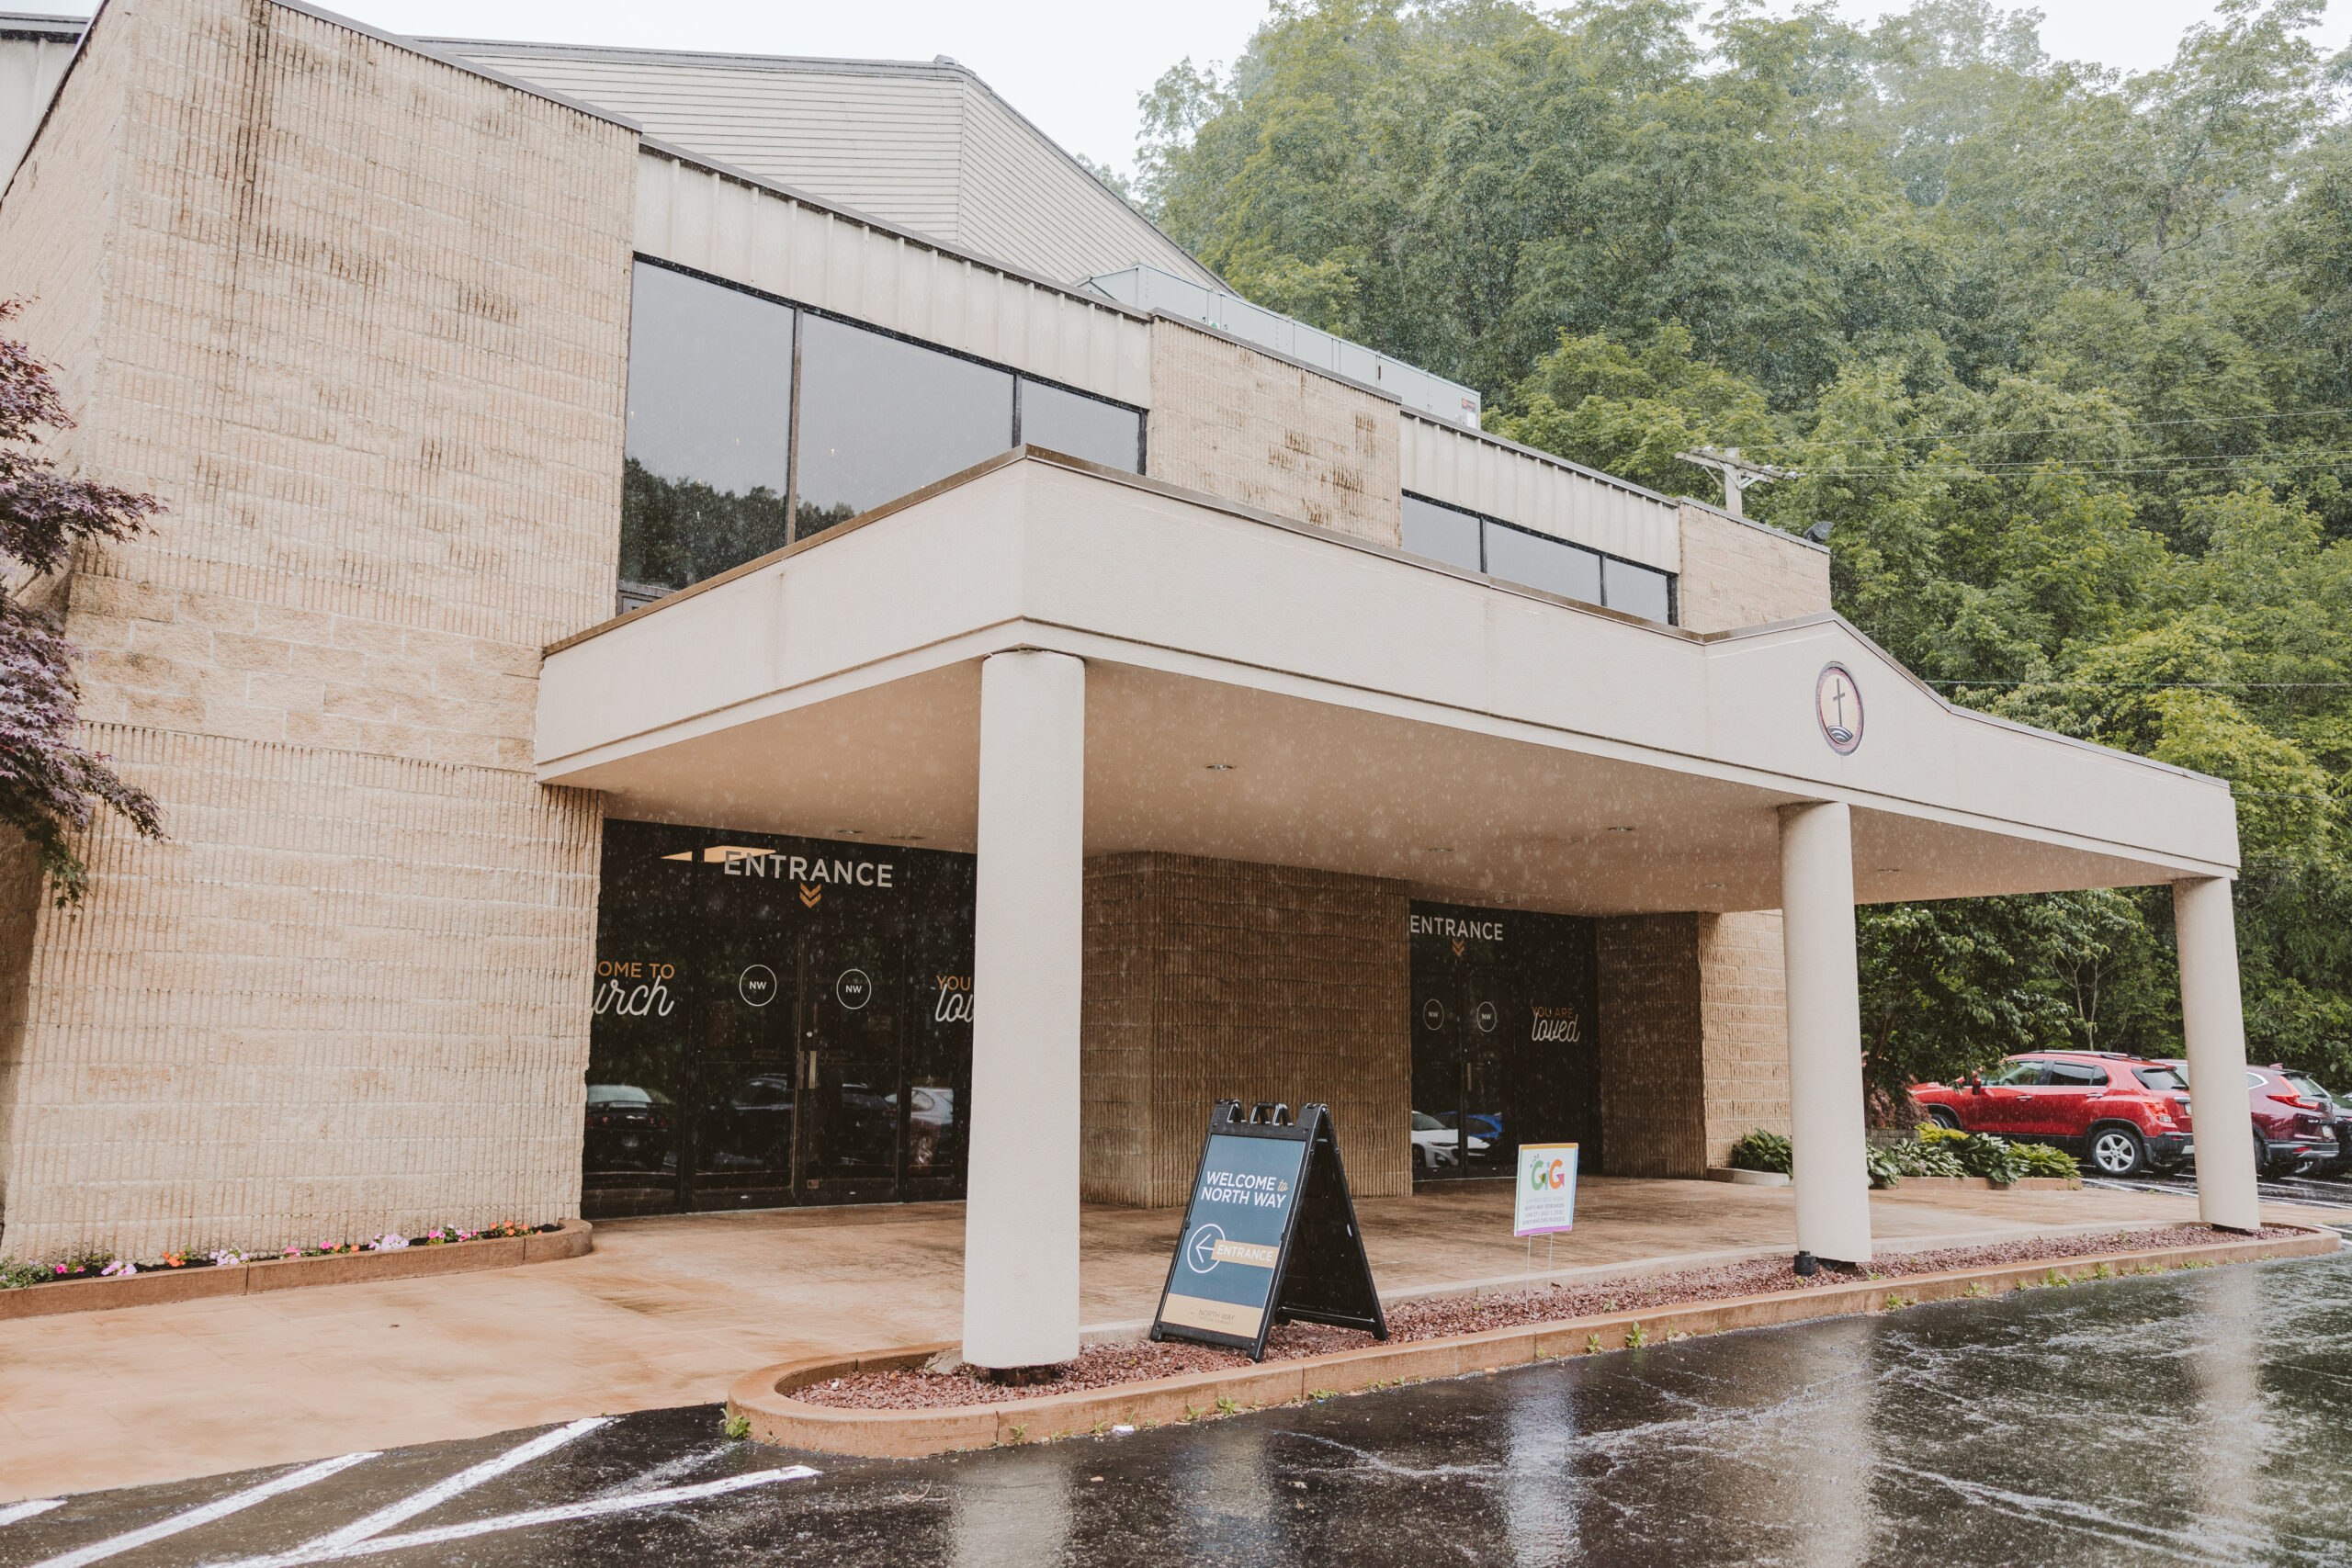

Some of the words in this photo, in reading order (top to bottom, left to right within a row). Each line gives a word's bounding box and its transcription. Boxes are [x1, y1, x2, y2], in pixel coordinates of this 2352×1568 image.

[724, 851, 893, 888] ENTRANCE
[1409, 915, 1503, 941] ENTRANCE
[597, 961, 642, 977] OME
[649, 963, 675, 980] TO
[749, 980, 767, 990] NW
[845, 985, 863, 994] NW
[936, 975, 971, 991] YOU
[1428, 1010, 1439, 1019] NW
[1531, 1006, 1552, 1018] YOU
[1554, 1007, 1574, 1019] ARE
[1532, 1011, 1581, 1043] loved
[1206, 1170, 1277, 1191] WELCOME
[1277, 1179, 1288, 1192] to
[1200, 1186, 1250, 1205] NORTH
[1253, 1191, 1286, 1209] WAY
[1216, 1243, 1273, 1263] ENTRANCE
[1198, 1309, 1221, 1319] NORTH
[1221, 1313, 1236, 1322] WAY
